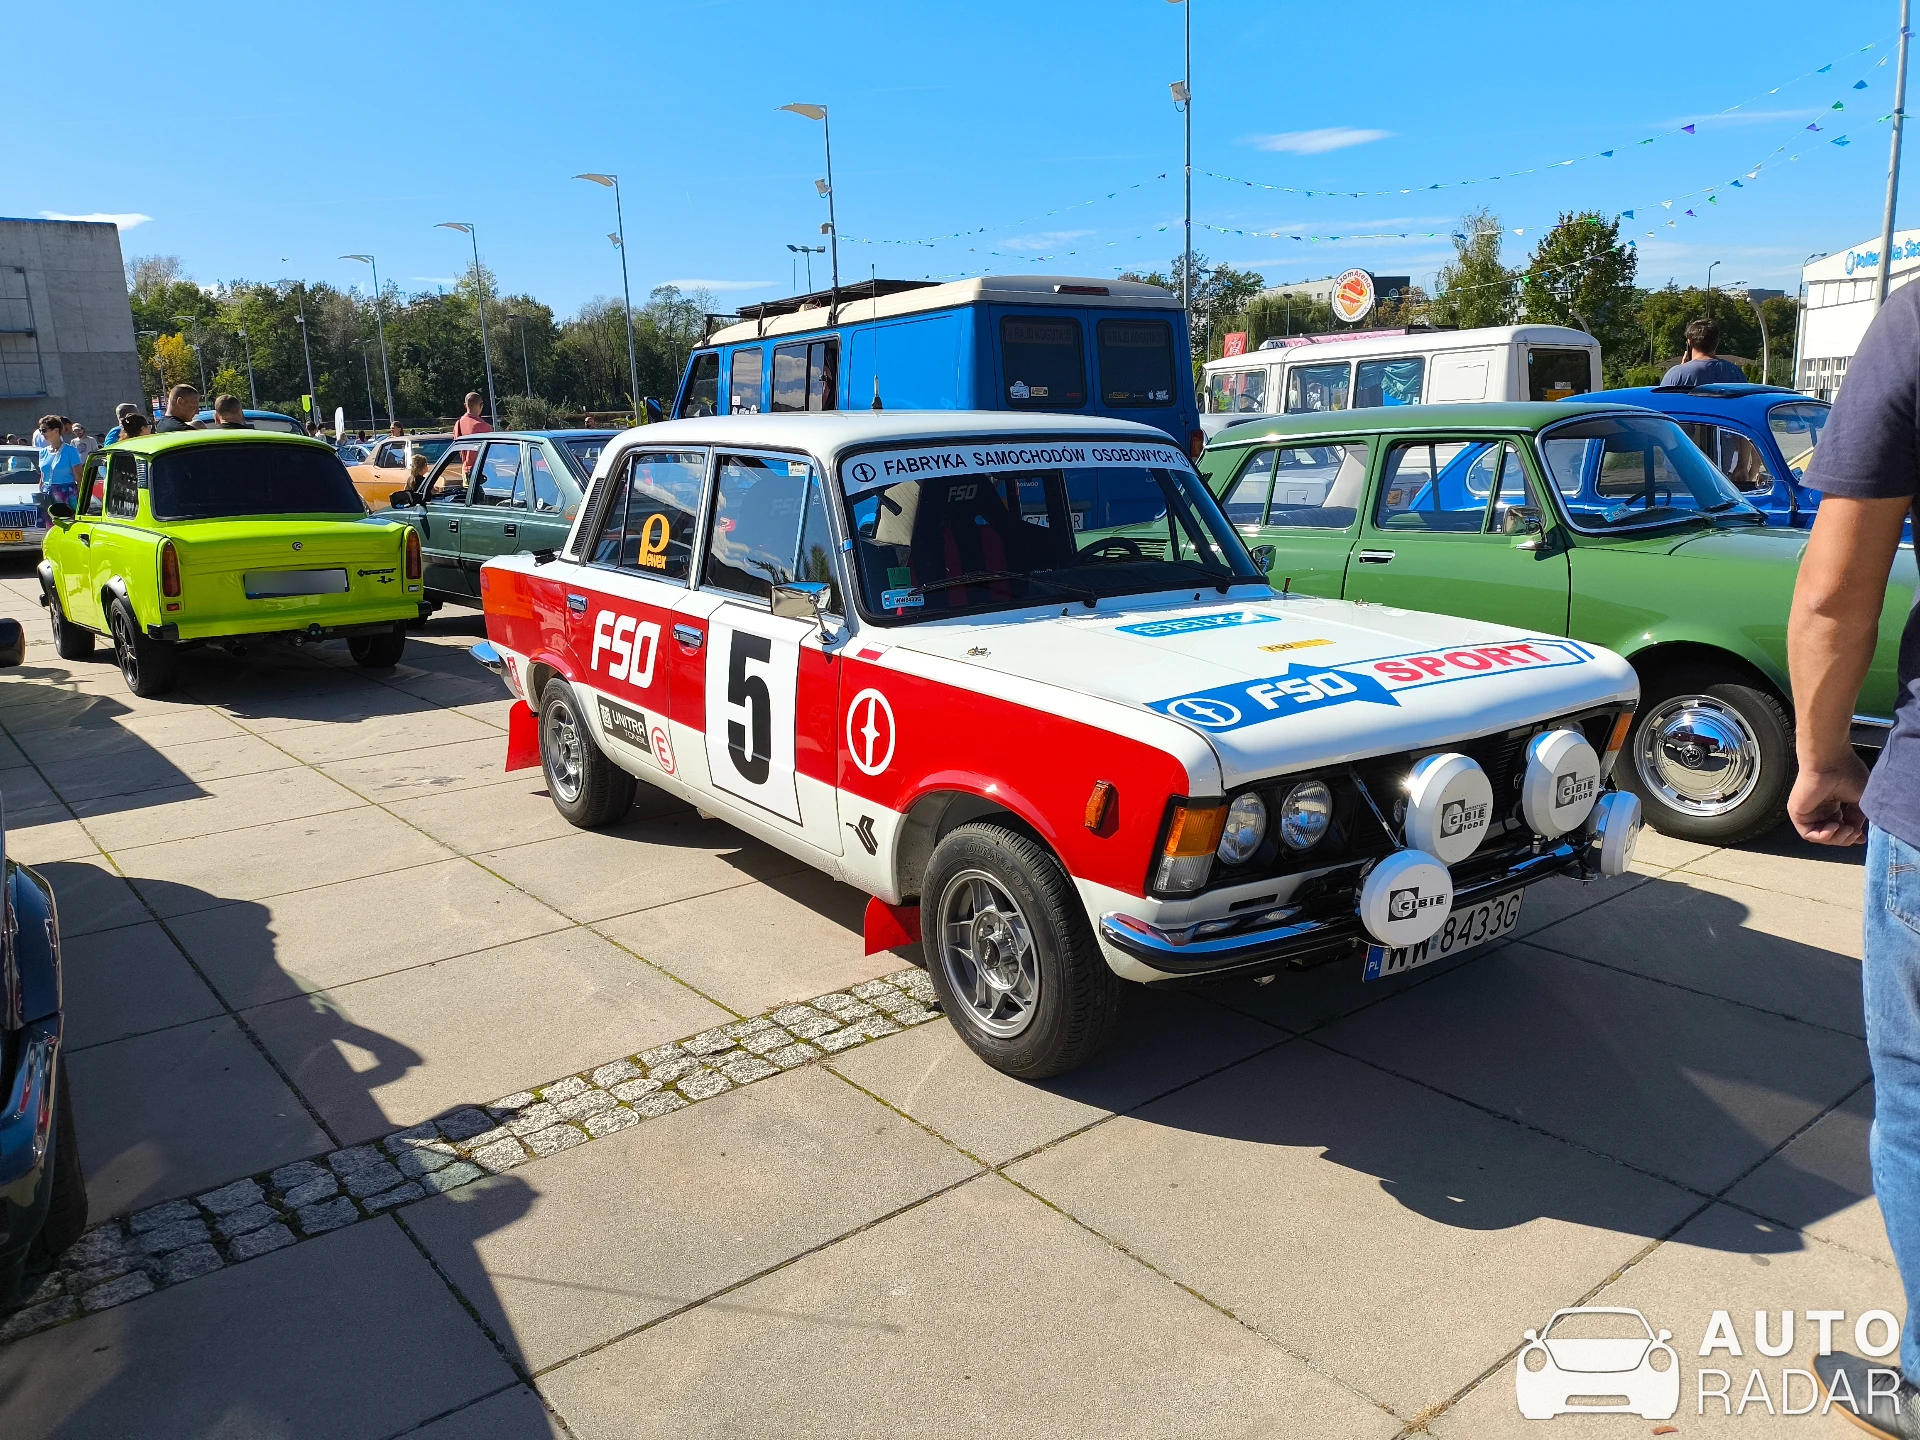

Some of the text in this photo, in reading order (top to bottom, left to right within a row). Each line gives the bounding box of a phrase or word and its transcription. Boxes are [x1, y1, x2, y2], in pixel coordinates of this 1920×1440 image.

[1336, 270, 1372, 289] SzamArena
[1035, 327, 1063, 341] KOGUTA
[883, 445, 1176, 476] FABRYKA SAMOCHODÓW OSOBOWYCH
[947, 484, 979, 502] FSO
[590, 609, 662, 689] FSO
[1245, 643, 1552, 711] FSO SPORT
[728, 629, 772, 785] 5
[612, 709, 647, 737] UNITRA
[1563, 780, 1594, 797] CIBIE
[1575, 791, 1593, 802] IODE
[1450, 808, 1486, 825] CIBIE
[1463, 820, 1485, 831] IODE
[1401, 895, 1446, 910] CIBIE
[1368, 960, 1380, 972] PL
[1440, 893, 1520, 953] 8433G
